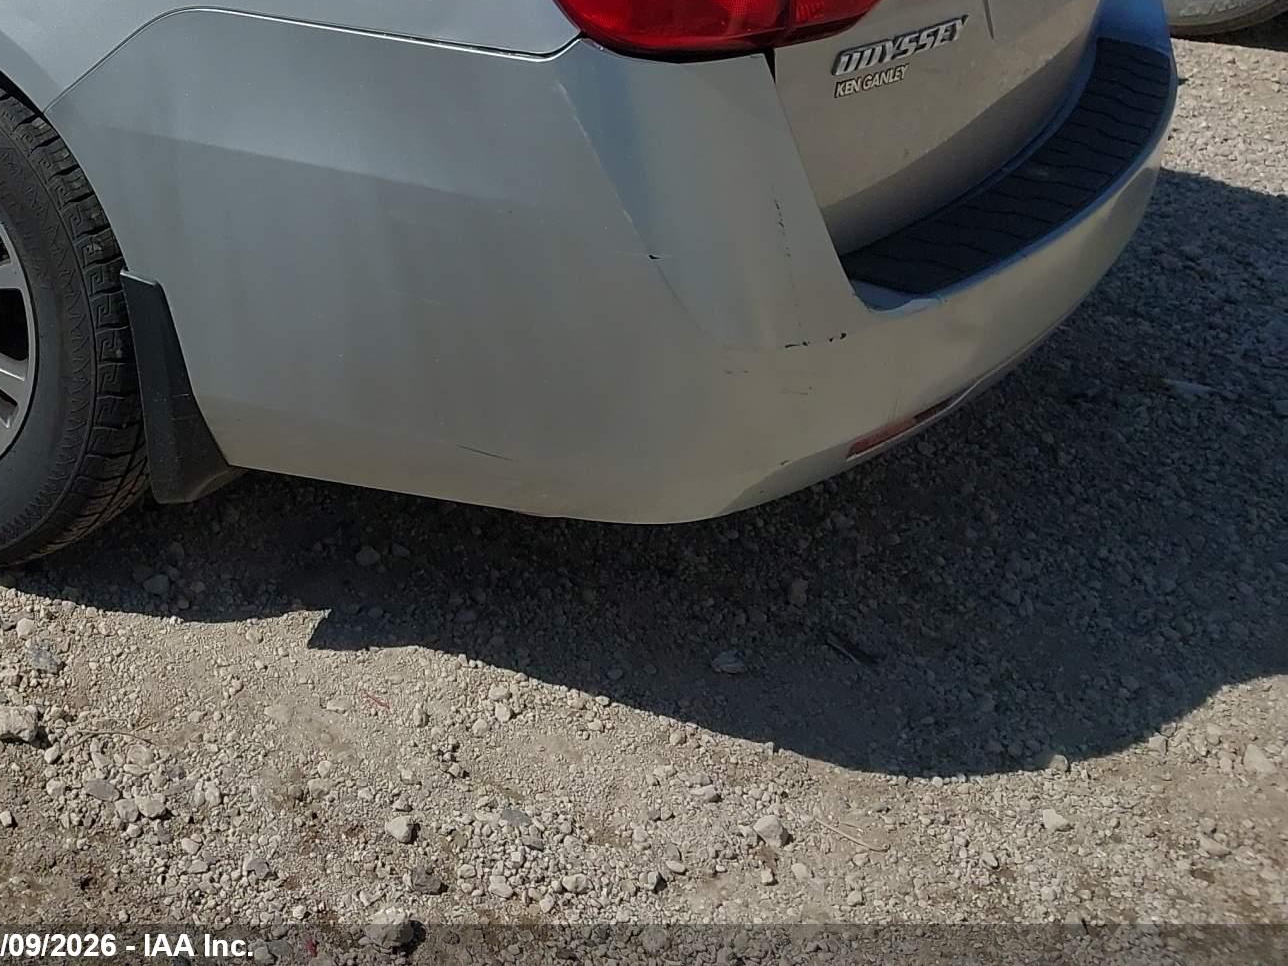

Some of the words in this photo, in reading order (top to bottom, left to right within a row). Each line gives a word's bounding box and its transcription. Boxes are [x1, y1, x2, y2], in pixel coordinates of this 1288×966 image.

[831, 14, 969, 76] ODYSSEY
[834, 78, 863, 99] KEN
[862, 63, 910, 91] GANLEY
